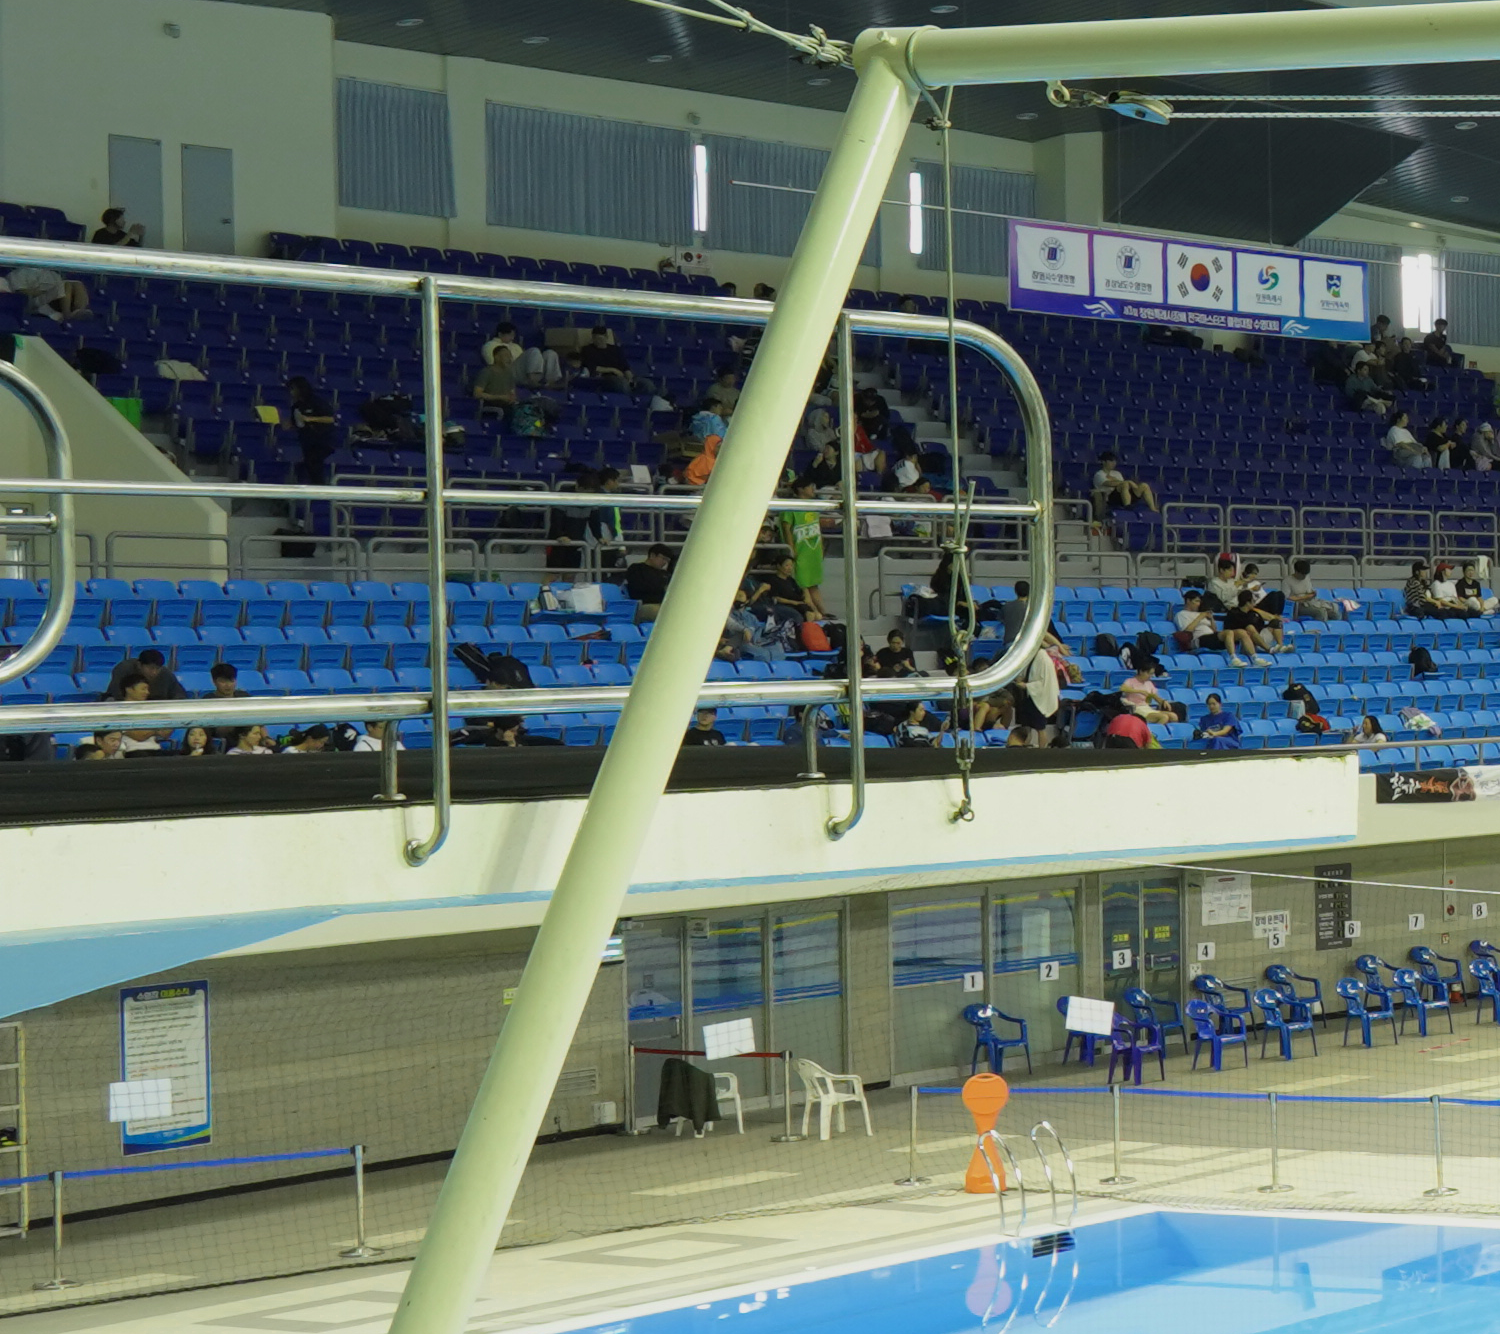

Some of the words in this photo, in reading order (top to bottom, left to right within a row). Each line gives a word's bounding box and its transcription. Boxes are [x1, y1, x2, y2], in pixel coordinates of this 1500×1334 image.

[1476, 905, 1483, 917] 8
[1412, 916, 1418, 928] 7
[1348, 923, 1355, 935] 6
[1273, 933, 1280, 946] 5
[1202, 945, 1209, 957] 4
[1118, 952, 1125, 965] 3
[1045, 964, 1052, 978] 2
[970, 975, 975, 988] 1
